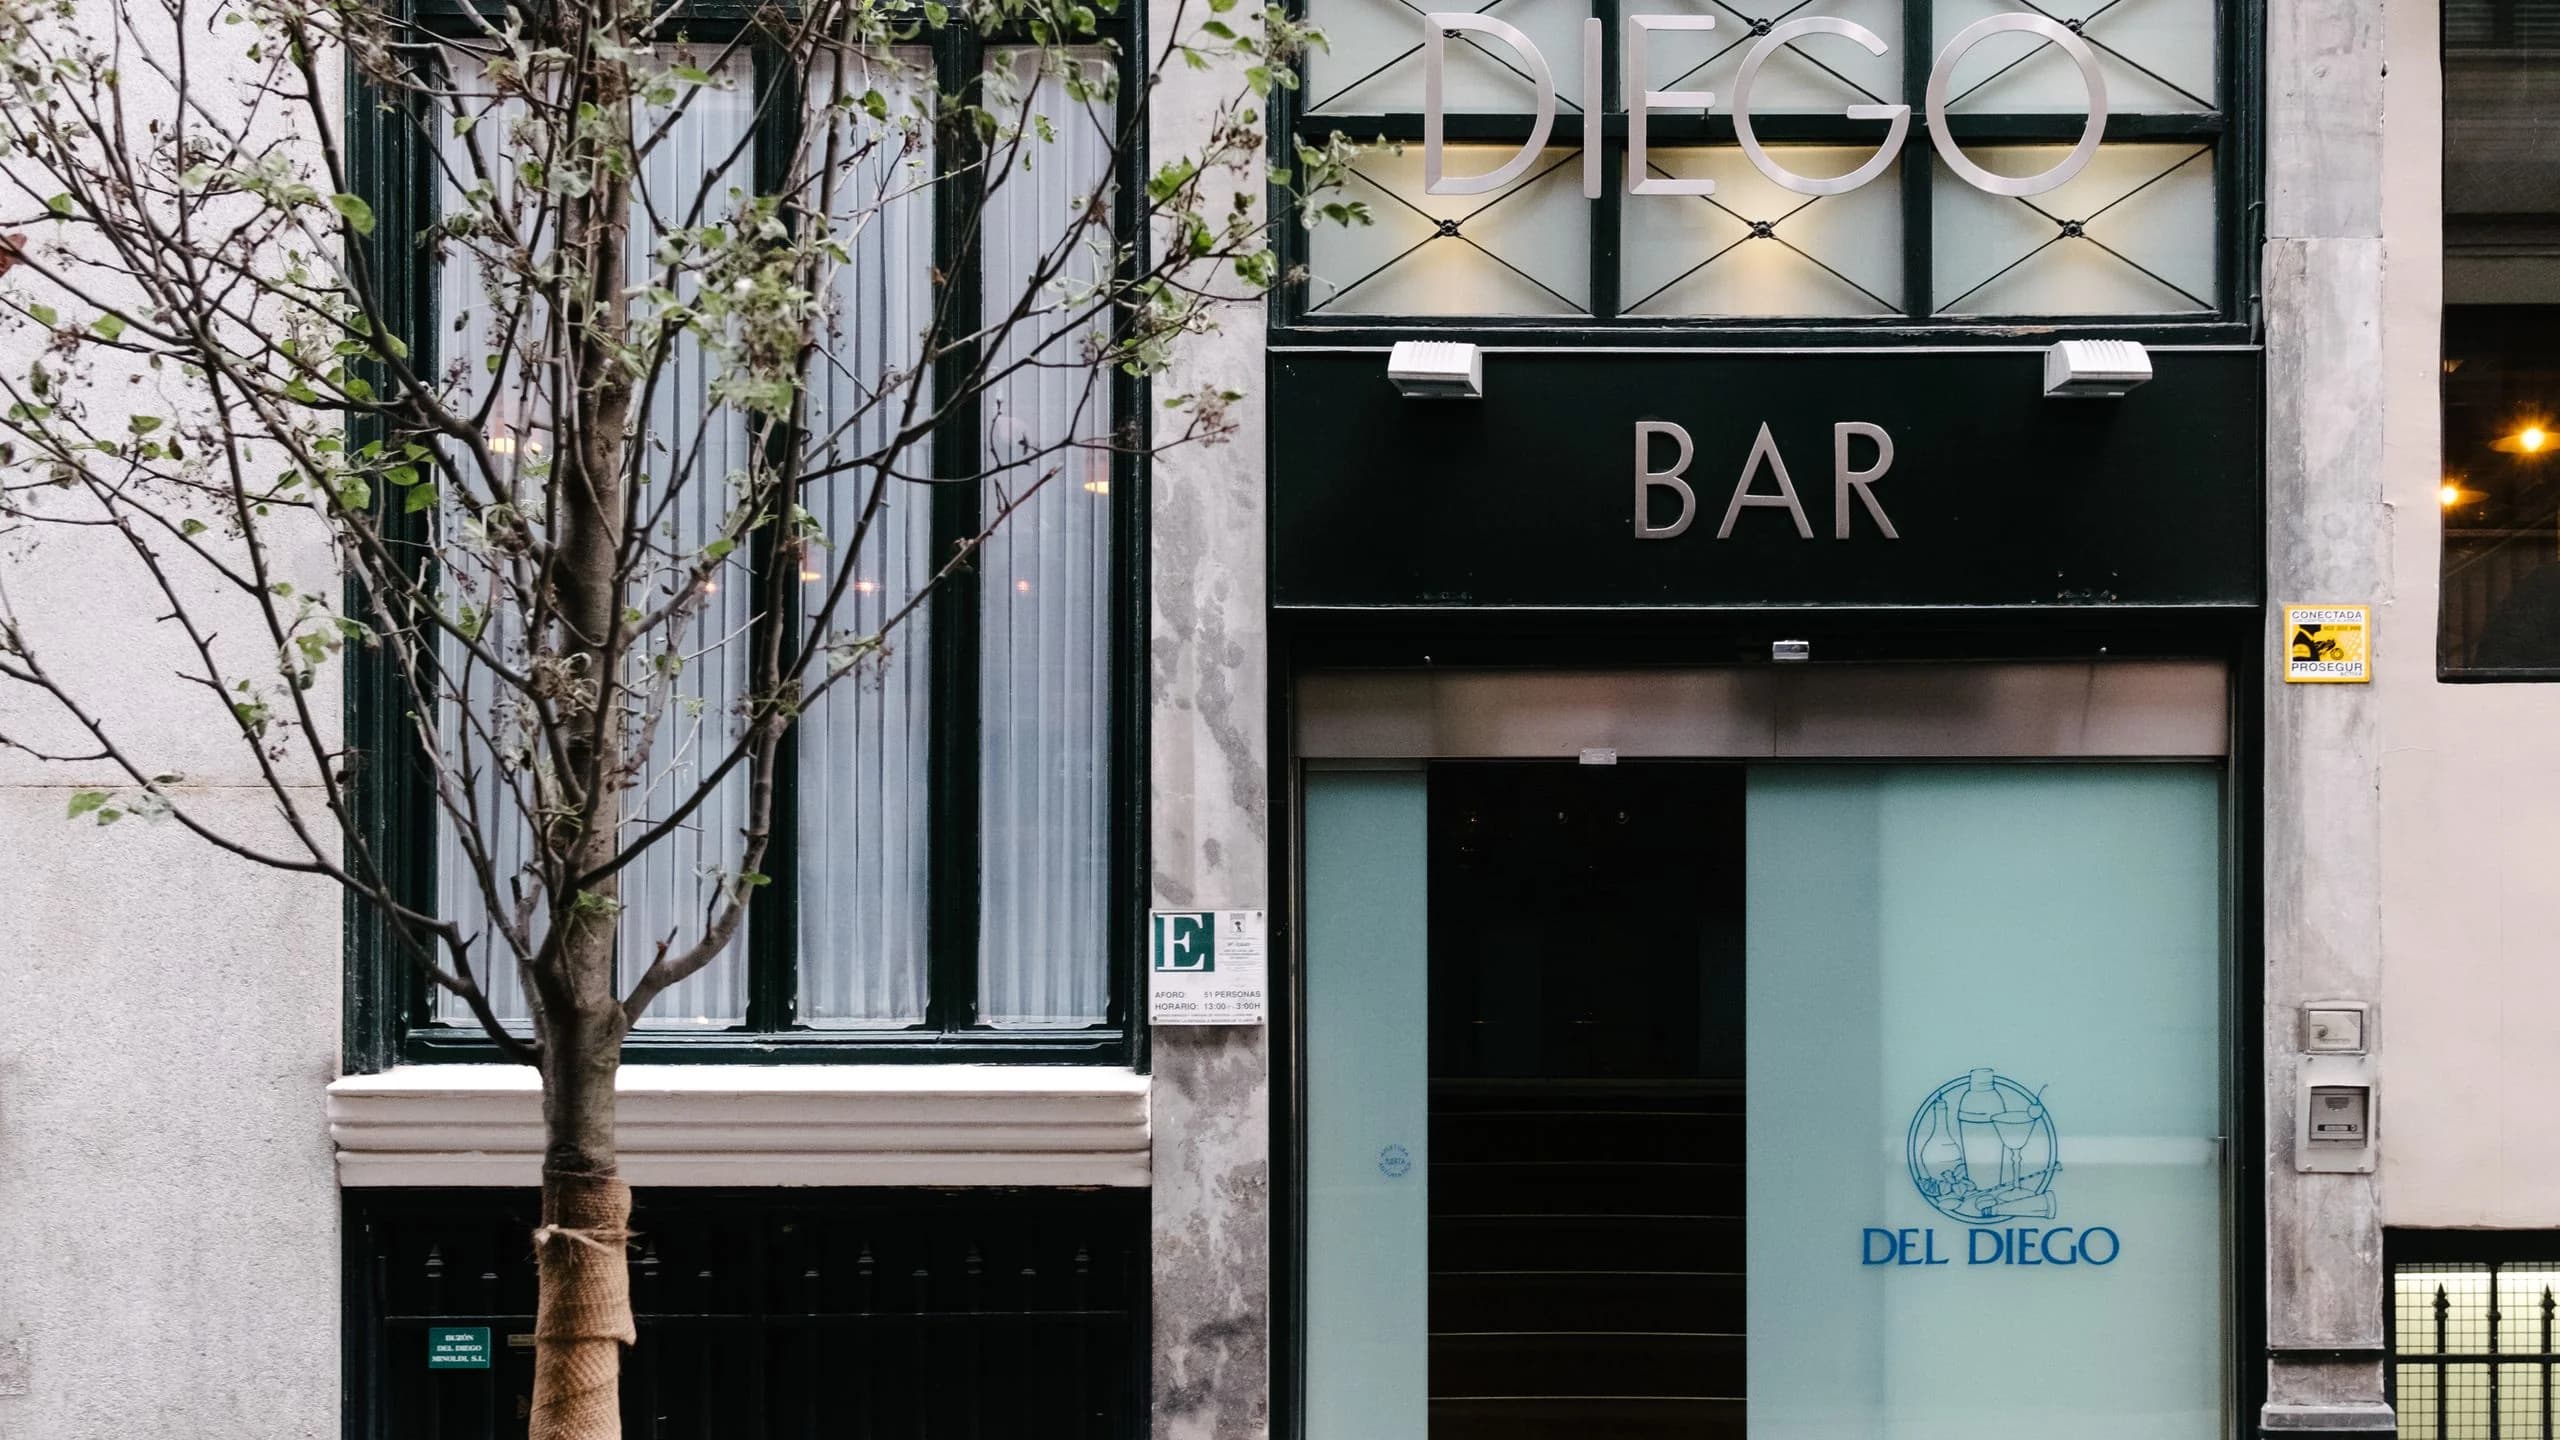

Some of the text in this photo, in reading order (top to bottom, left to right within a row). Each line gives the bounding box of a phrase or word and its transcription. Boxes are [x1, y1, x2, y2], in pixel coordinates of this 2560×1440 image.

[1424, 12, 2107, 199] DIEGO
[1635, 421, 1899, 539] BAR
[2292, 610, 2362, 619] CONECTADA
[2291, 662, 2363, 672] PROSEGUR
[1156, 913, 1205, 970] E
[1215, 990, 1261, 998] PERSONAS
[1862, 1226, 2120, 1265] DEL DIEGO
